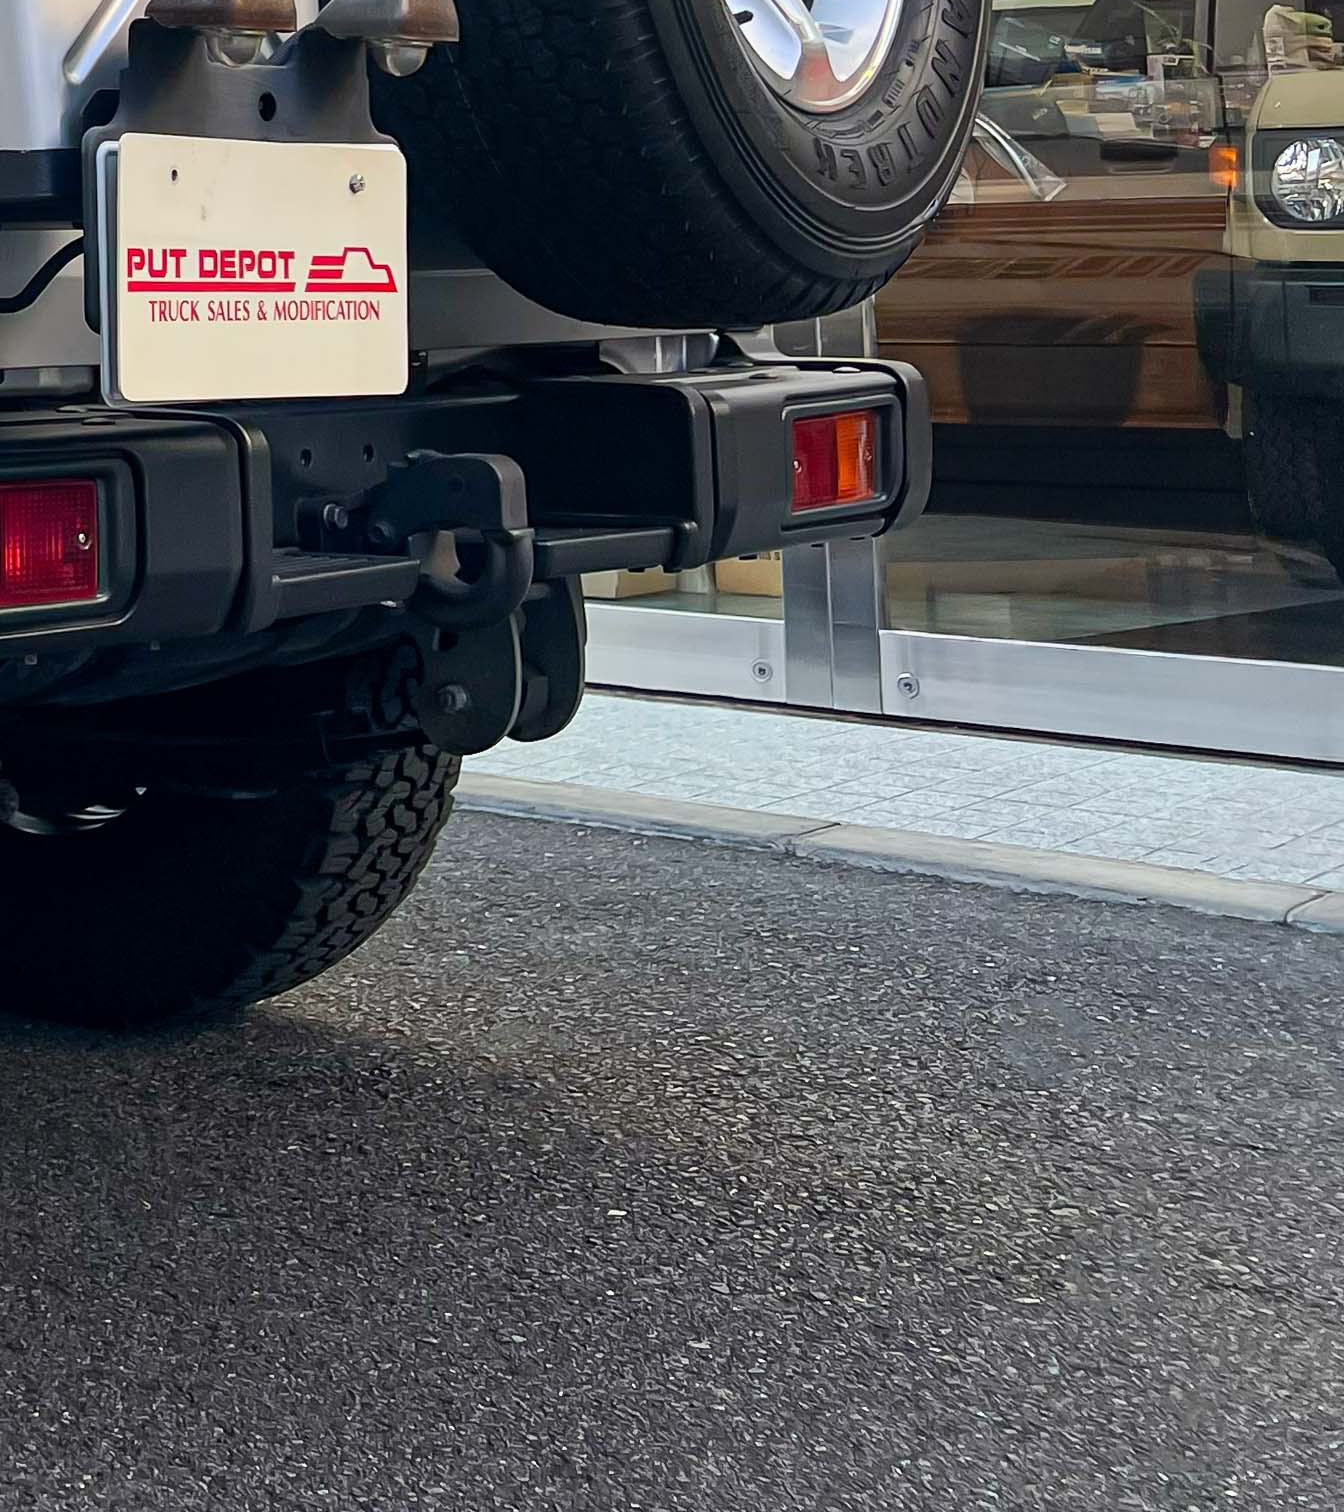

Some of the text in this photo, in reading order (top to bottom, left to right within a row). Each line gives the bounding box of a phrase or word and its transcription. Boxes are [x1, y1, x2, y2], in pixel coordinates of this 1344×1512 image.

[127, 248, 295, 279] PUT DEPOT
[148, 300, 380, 322] TRUCK SALES & MODIFICATION
